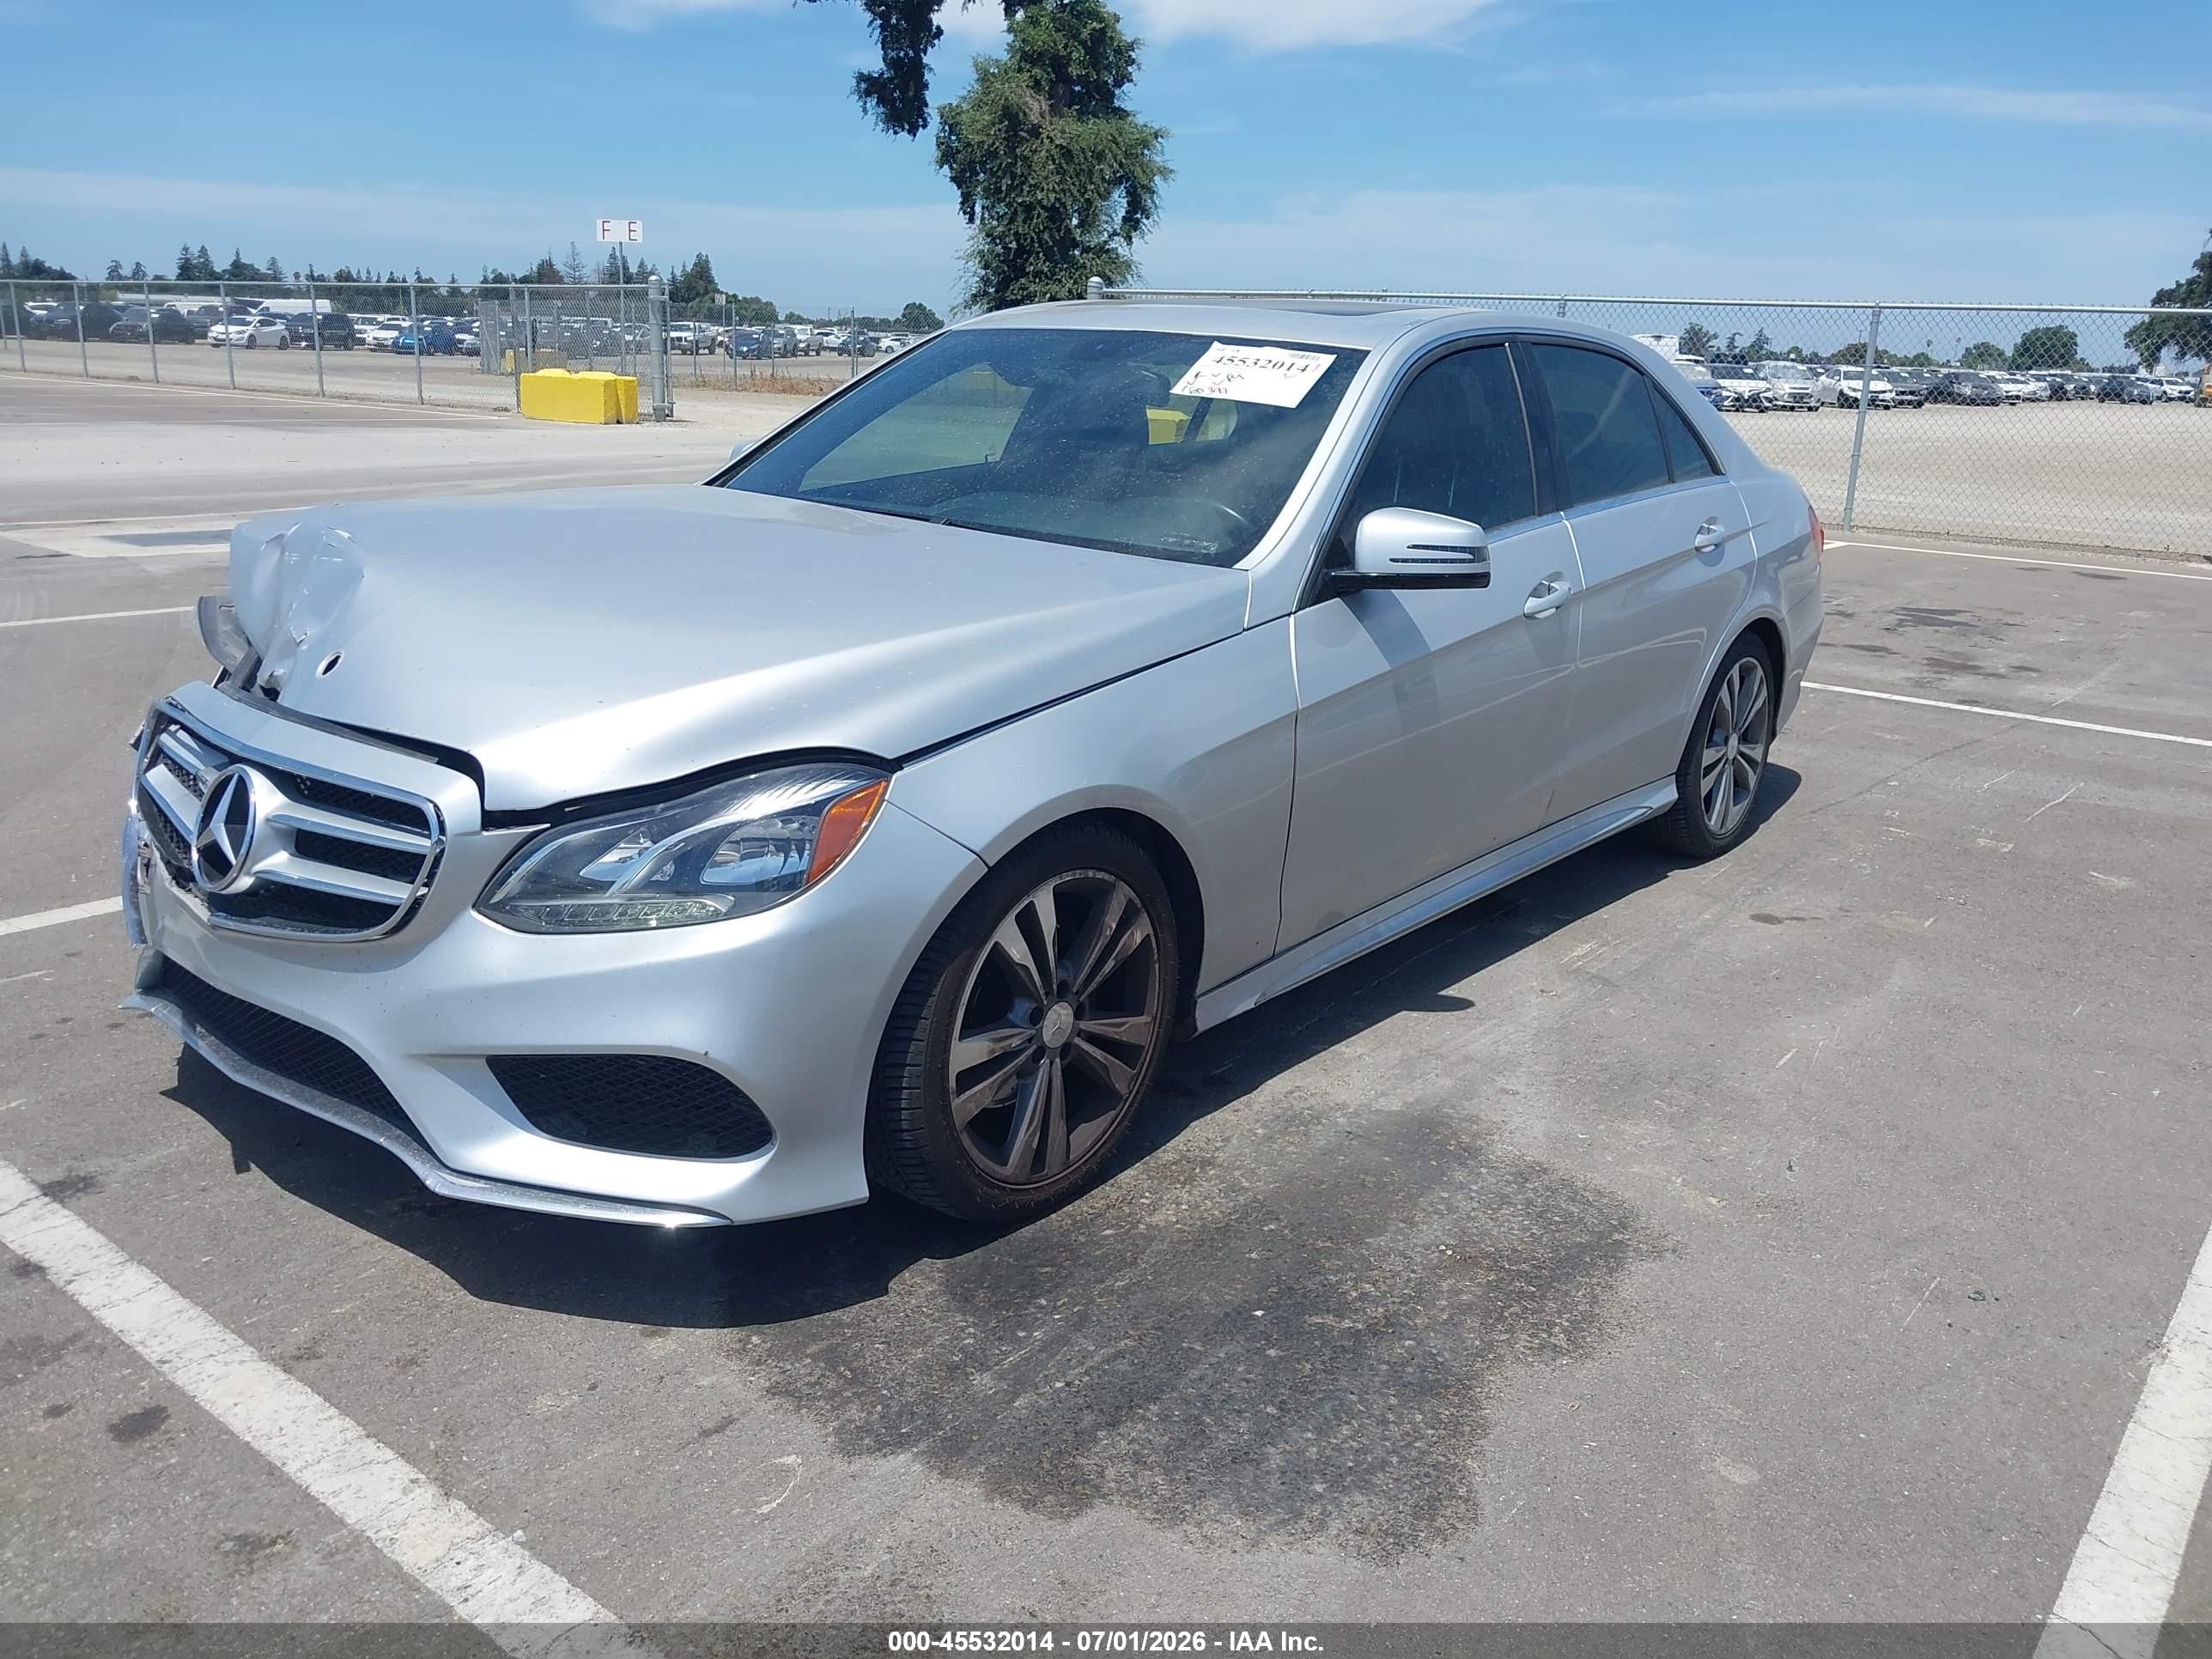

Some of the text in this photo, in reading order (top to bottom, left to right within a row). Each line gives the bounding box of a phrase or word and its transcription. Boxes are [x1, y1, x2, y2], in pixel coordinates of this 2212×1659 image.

[602, 220, 638, 241] F E
[1212, 355, 1310, 373] 45532014
